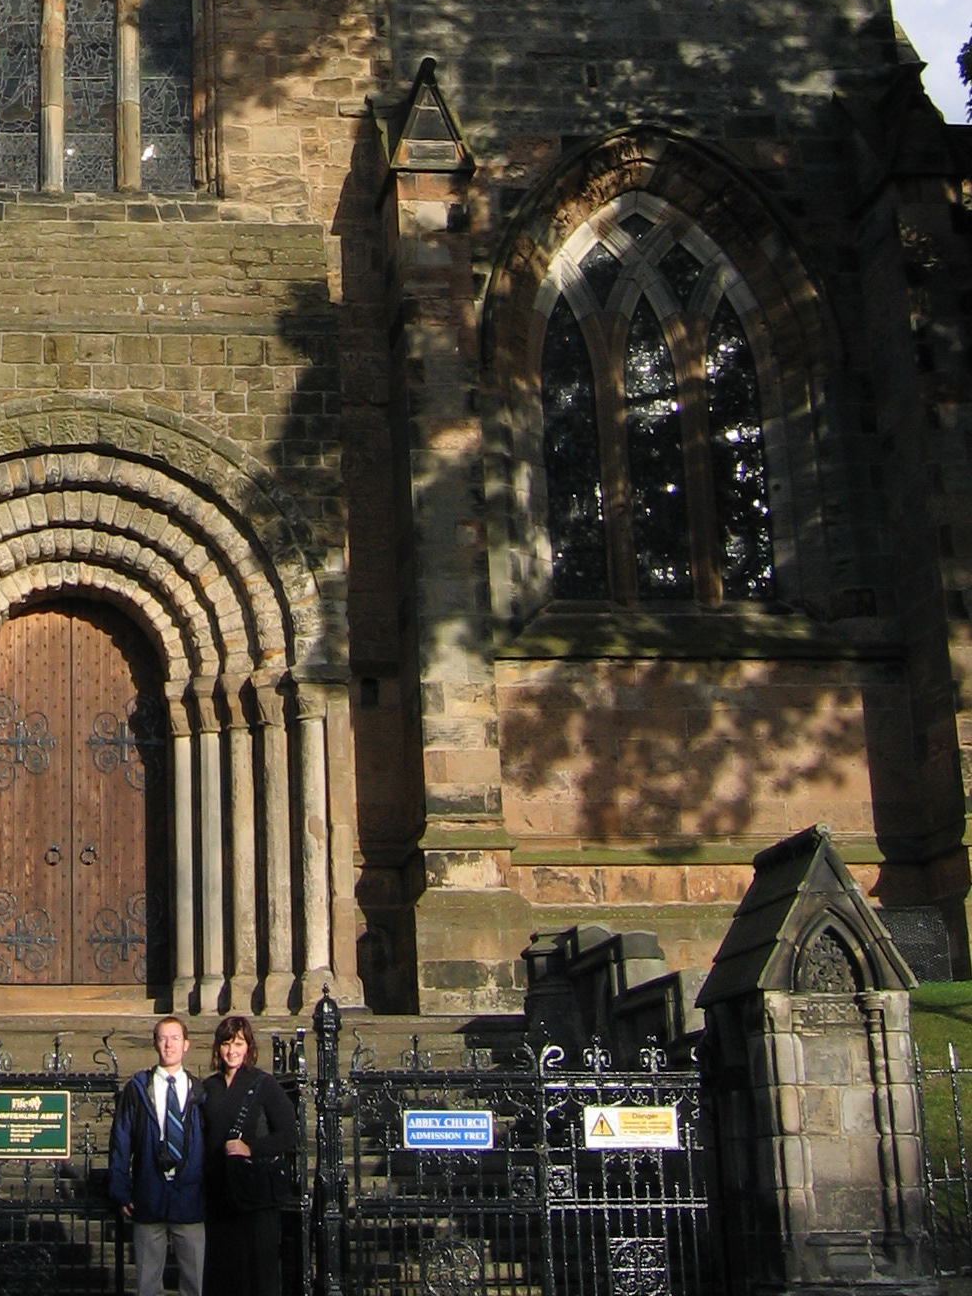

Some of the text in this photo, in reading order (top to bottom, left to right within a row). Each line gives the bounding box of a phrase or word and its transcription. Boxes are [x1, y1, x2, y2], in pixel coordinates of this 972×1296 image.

[40, 1112, 64, 1120] ABBEY
[631, 1112, 658, 1120] Danger
[408, 1118, 488, 1127] ABBEY CHURCH
[410, 1132, 488, 1140] ADMISSION FREE
